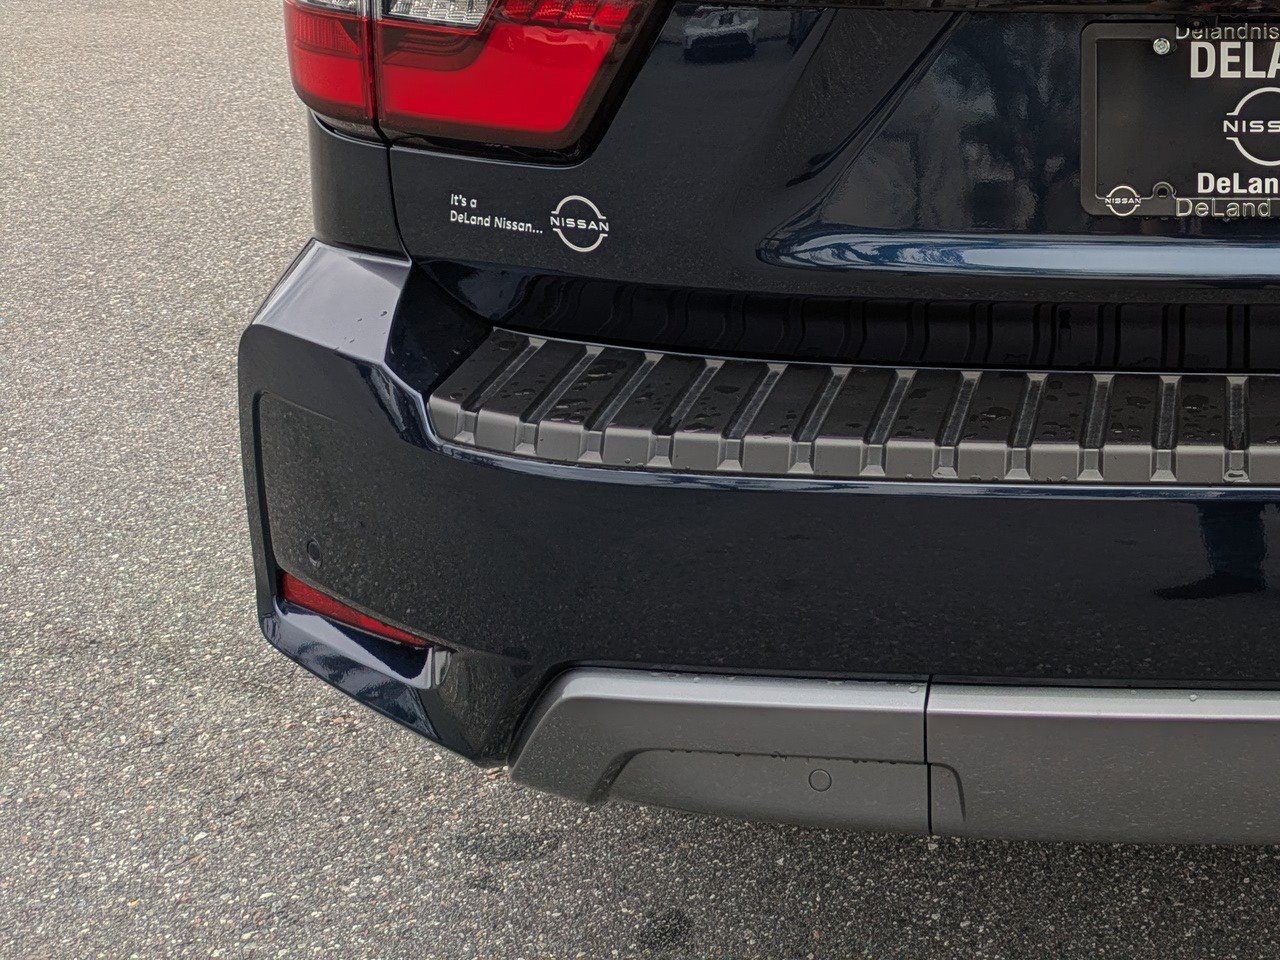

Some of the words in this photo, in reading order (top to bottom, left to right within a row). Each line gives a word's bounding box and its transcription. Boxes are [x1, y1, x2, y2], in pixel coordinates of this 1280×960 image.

[450, 193, 467, 207] It's
[470, 198, 477, 208] a
[1175, 198, 1271, 217] DeLand
[450, 210, 491, 227] DeLand
[494, 217, 543, 234] Nissan...
[550, 216, 609, 232] NISSAN
